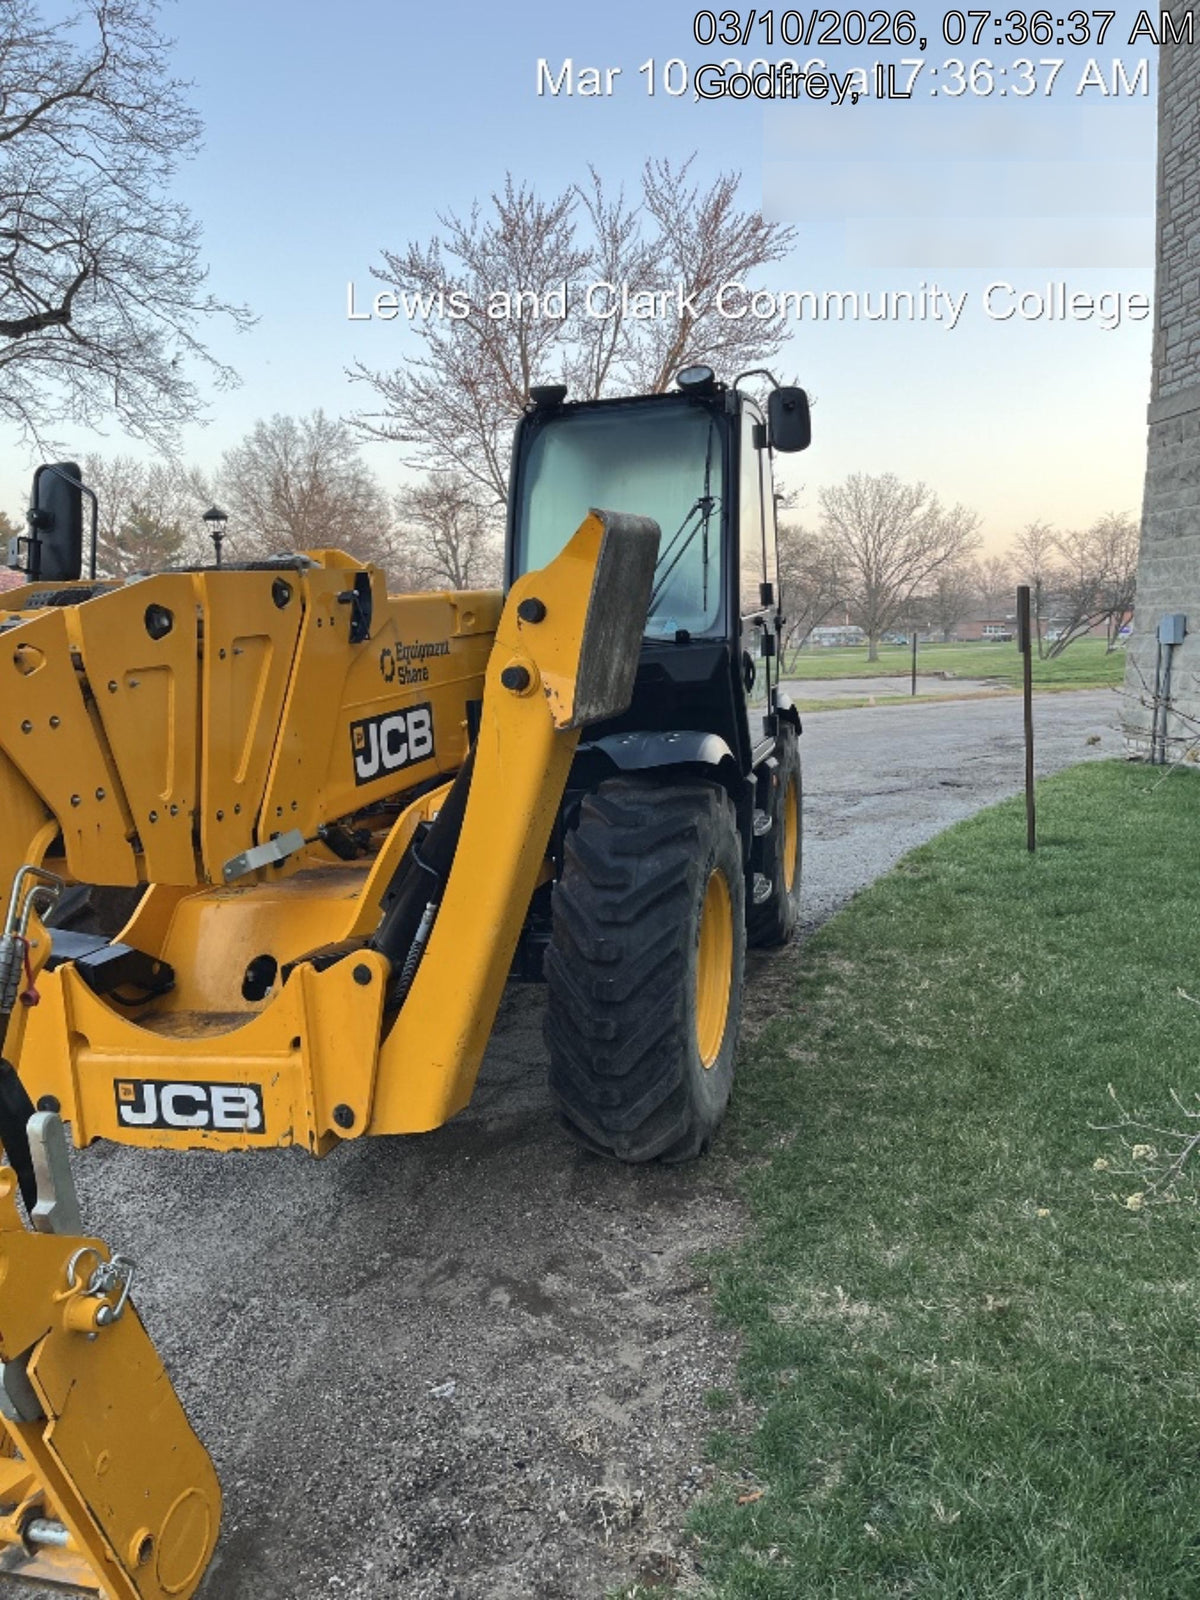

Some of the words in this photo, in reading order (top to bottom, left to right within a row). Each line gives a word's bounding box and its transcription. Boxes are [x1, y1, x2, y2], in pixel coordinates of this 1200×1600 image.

[395, 640, 450, 665] Equipment
[398, 666, 429, 685] Share
[355, 708, 434, 778] JCB
[119, 1083, 262, 1129] JCB
